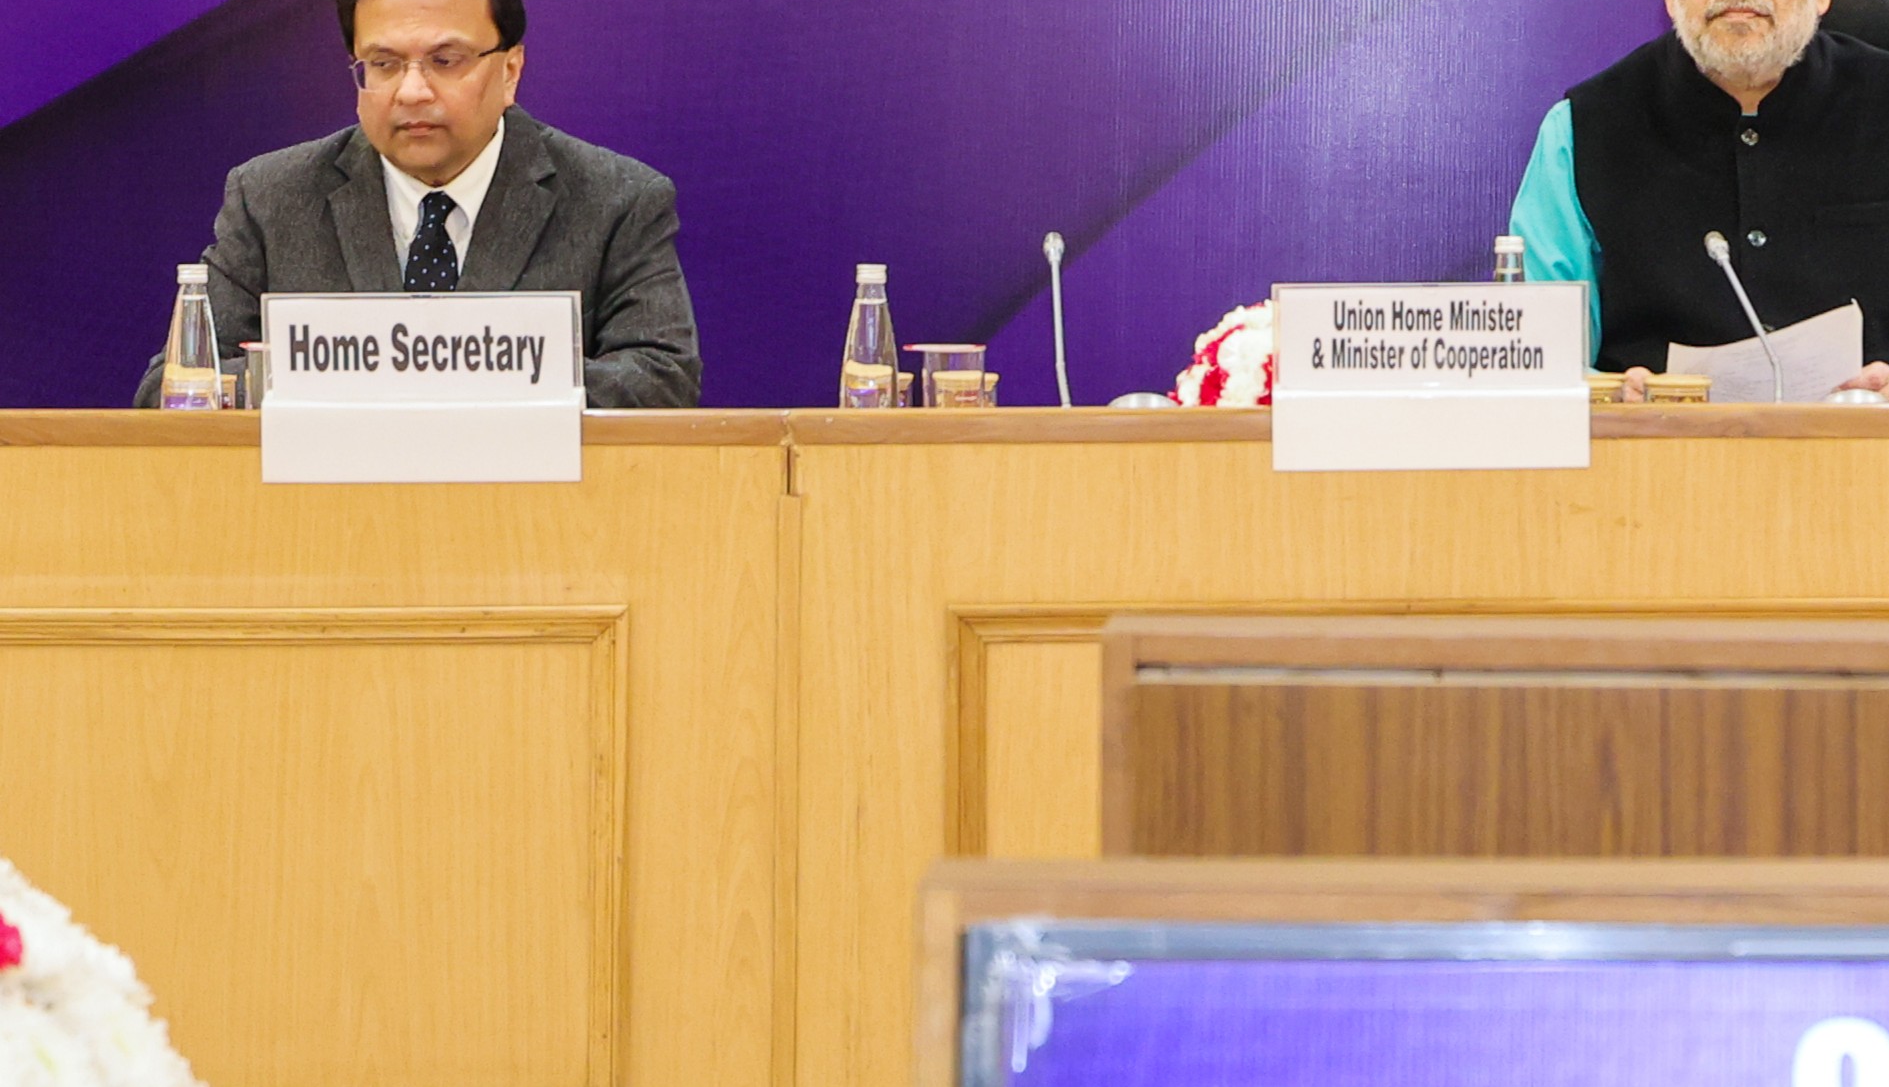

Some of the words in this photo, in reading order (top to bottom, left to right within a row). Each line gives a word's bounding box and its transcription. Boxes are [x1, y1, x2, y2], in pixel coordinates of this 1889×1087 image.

[1333, 300, 1385, 332] Union
[1391, 300, 1443, 332] Home
[1449, 300, 1523, 332] Minister
[289, 324, 380, 372] Home
[391, 323, 546, 384] Secretary
[1312, 339, 1325, 369] &
[1331, 338, 1405, 370] Minister
[1411, 338, 1429, 370] of
[1434, 338, 1544, 378] Cooperation
